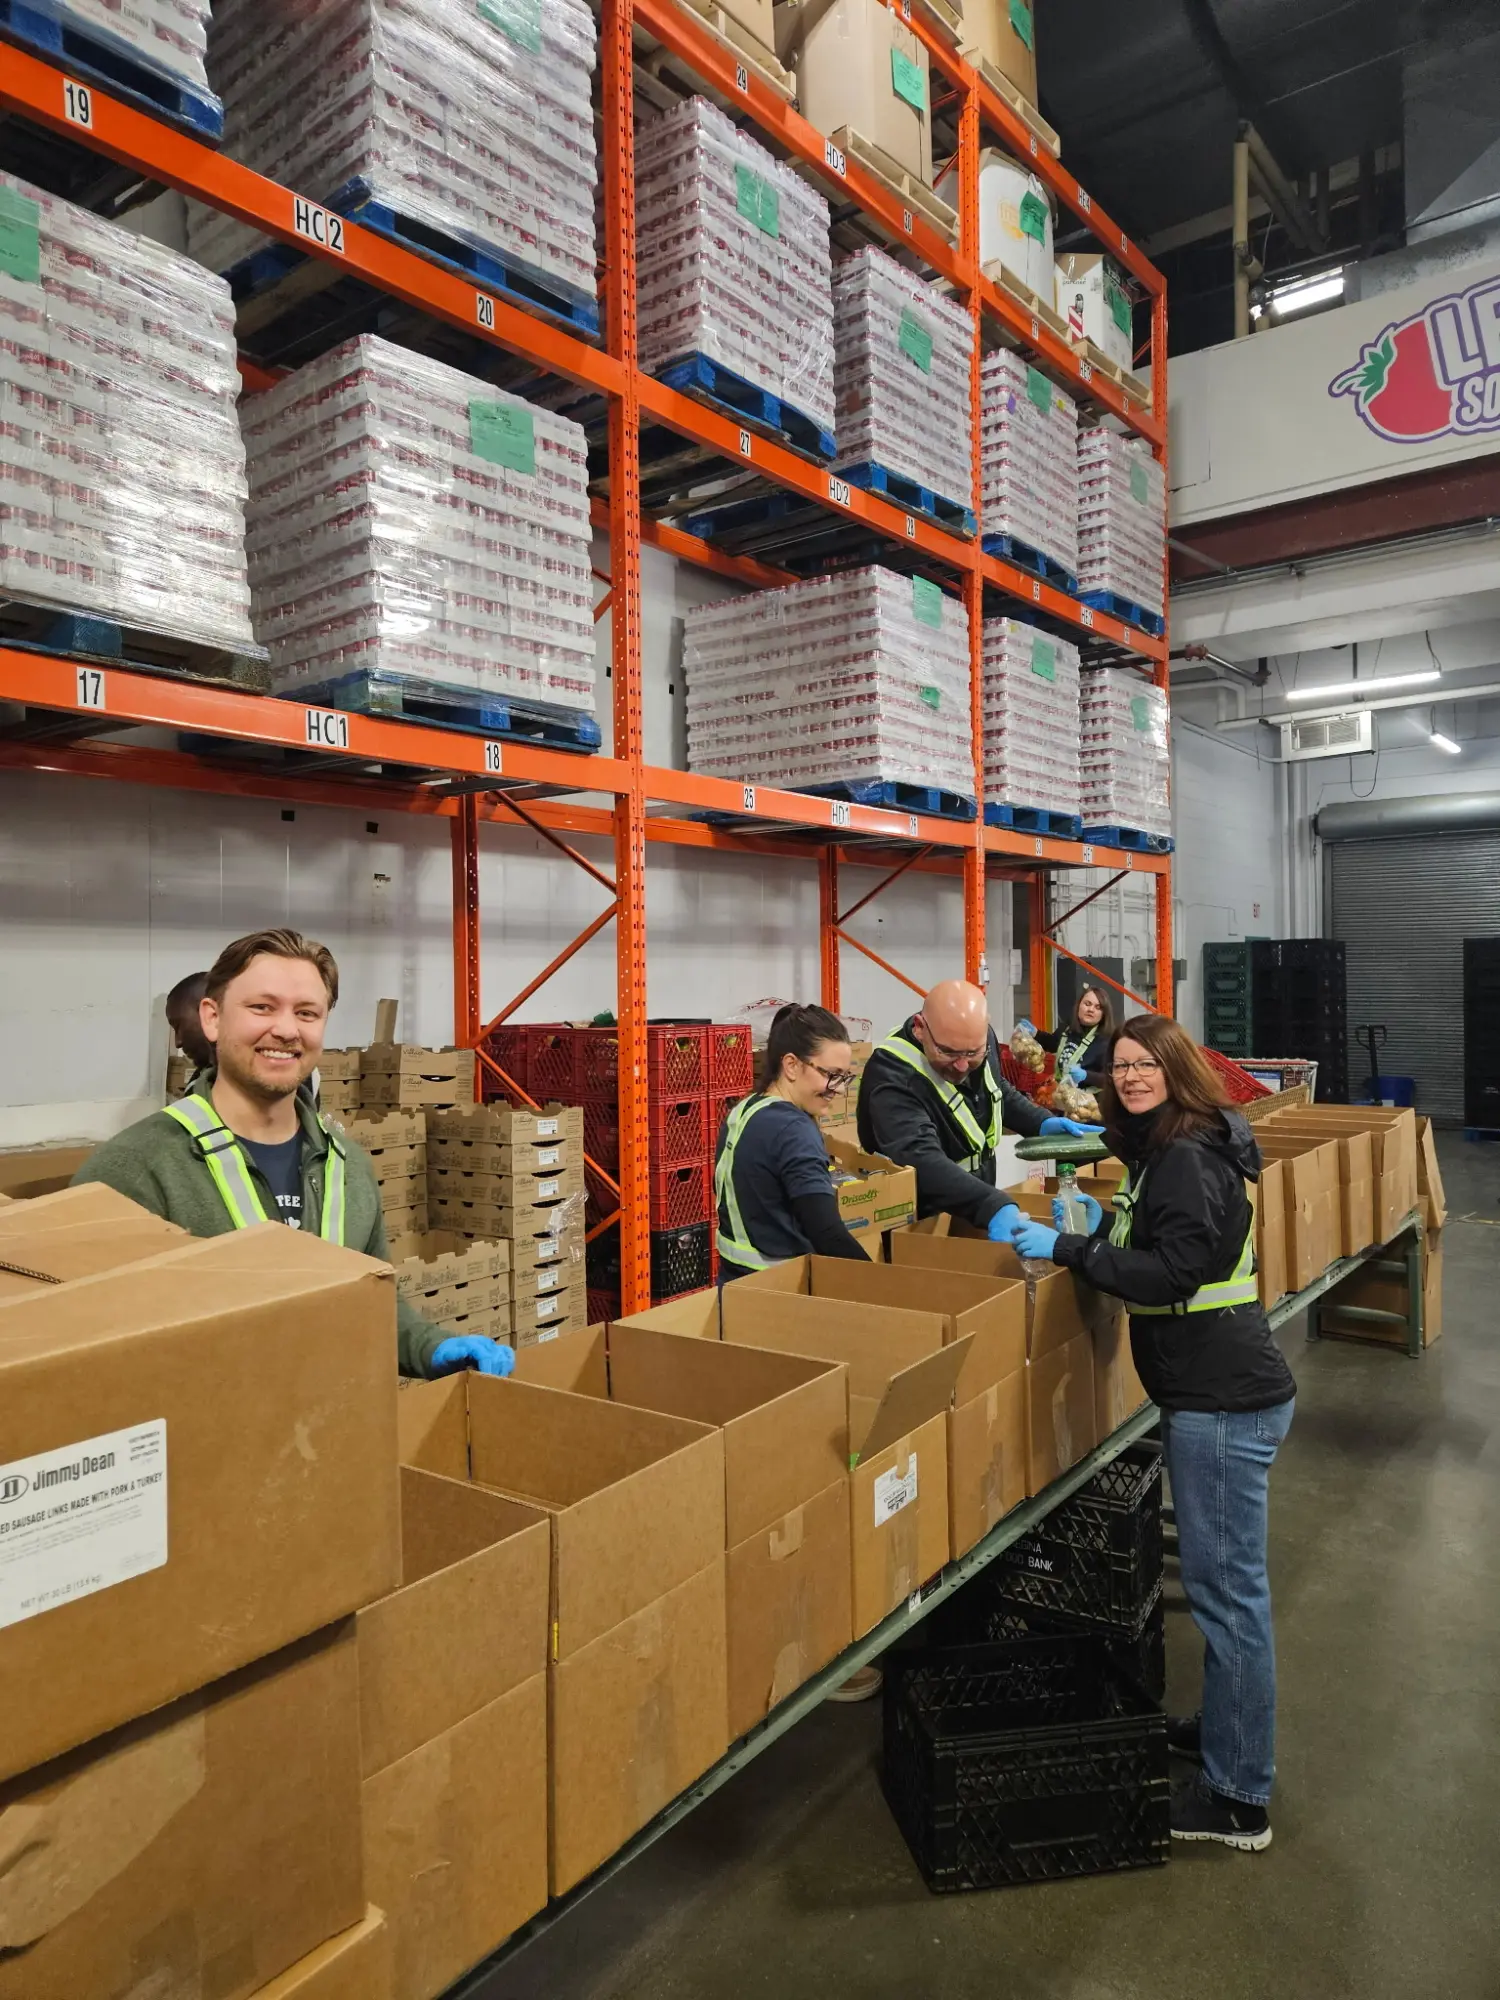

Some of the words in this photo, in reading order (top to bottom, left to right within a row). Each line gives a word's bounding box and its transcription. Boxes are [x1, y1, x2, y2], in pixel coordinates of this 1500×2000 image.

[736, 65, 747, 91] 29
[66, 83, 89, 124] 19
[826, 142, 846, 176] HD3
[296, 199, 343, 251] HC2
[904, 211, 912, 232] 30
[478, 296, 492, 326] 20
[740, 431, 750, 454] 27
[829, 477, 849, 506] HD2
[907, 517, 914, 537] 28
[79, 670, 101, 705] 17
[308, 710, 347, 747] HC1
[486, 743, 500, 770] 18
[744, 788, 754, 809] 25
[832, 803, 849, 825] HD1
[275, 1194, 303, 1208] TEE
[841, 1188, 880, 1206] Driscoll's
[33, 1462, 81, 1492] Jimmy
[82, 1451, 116, 1477] Dean
[12, 1510, 46, 1530] SAUSAGE
[47, 1502, 69, 1519] LINKS
[70, 1495, 90, 1510] MADE
[91, 1490, 110, 1504] WITH
[110, 1484, 129, 1498] PORK
[130, 1480, 136, 1491] &
[136, 1471, 164, 1488] TURKEY
[1015, 1539, 1042, 1554] EGINA
[1028, 1555, 1053, 1572] BANK
[20, 1597, 36, 1610] NET
[61, 1583, 72, 1595] LB
